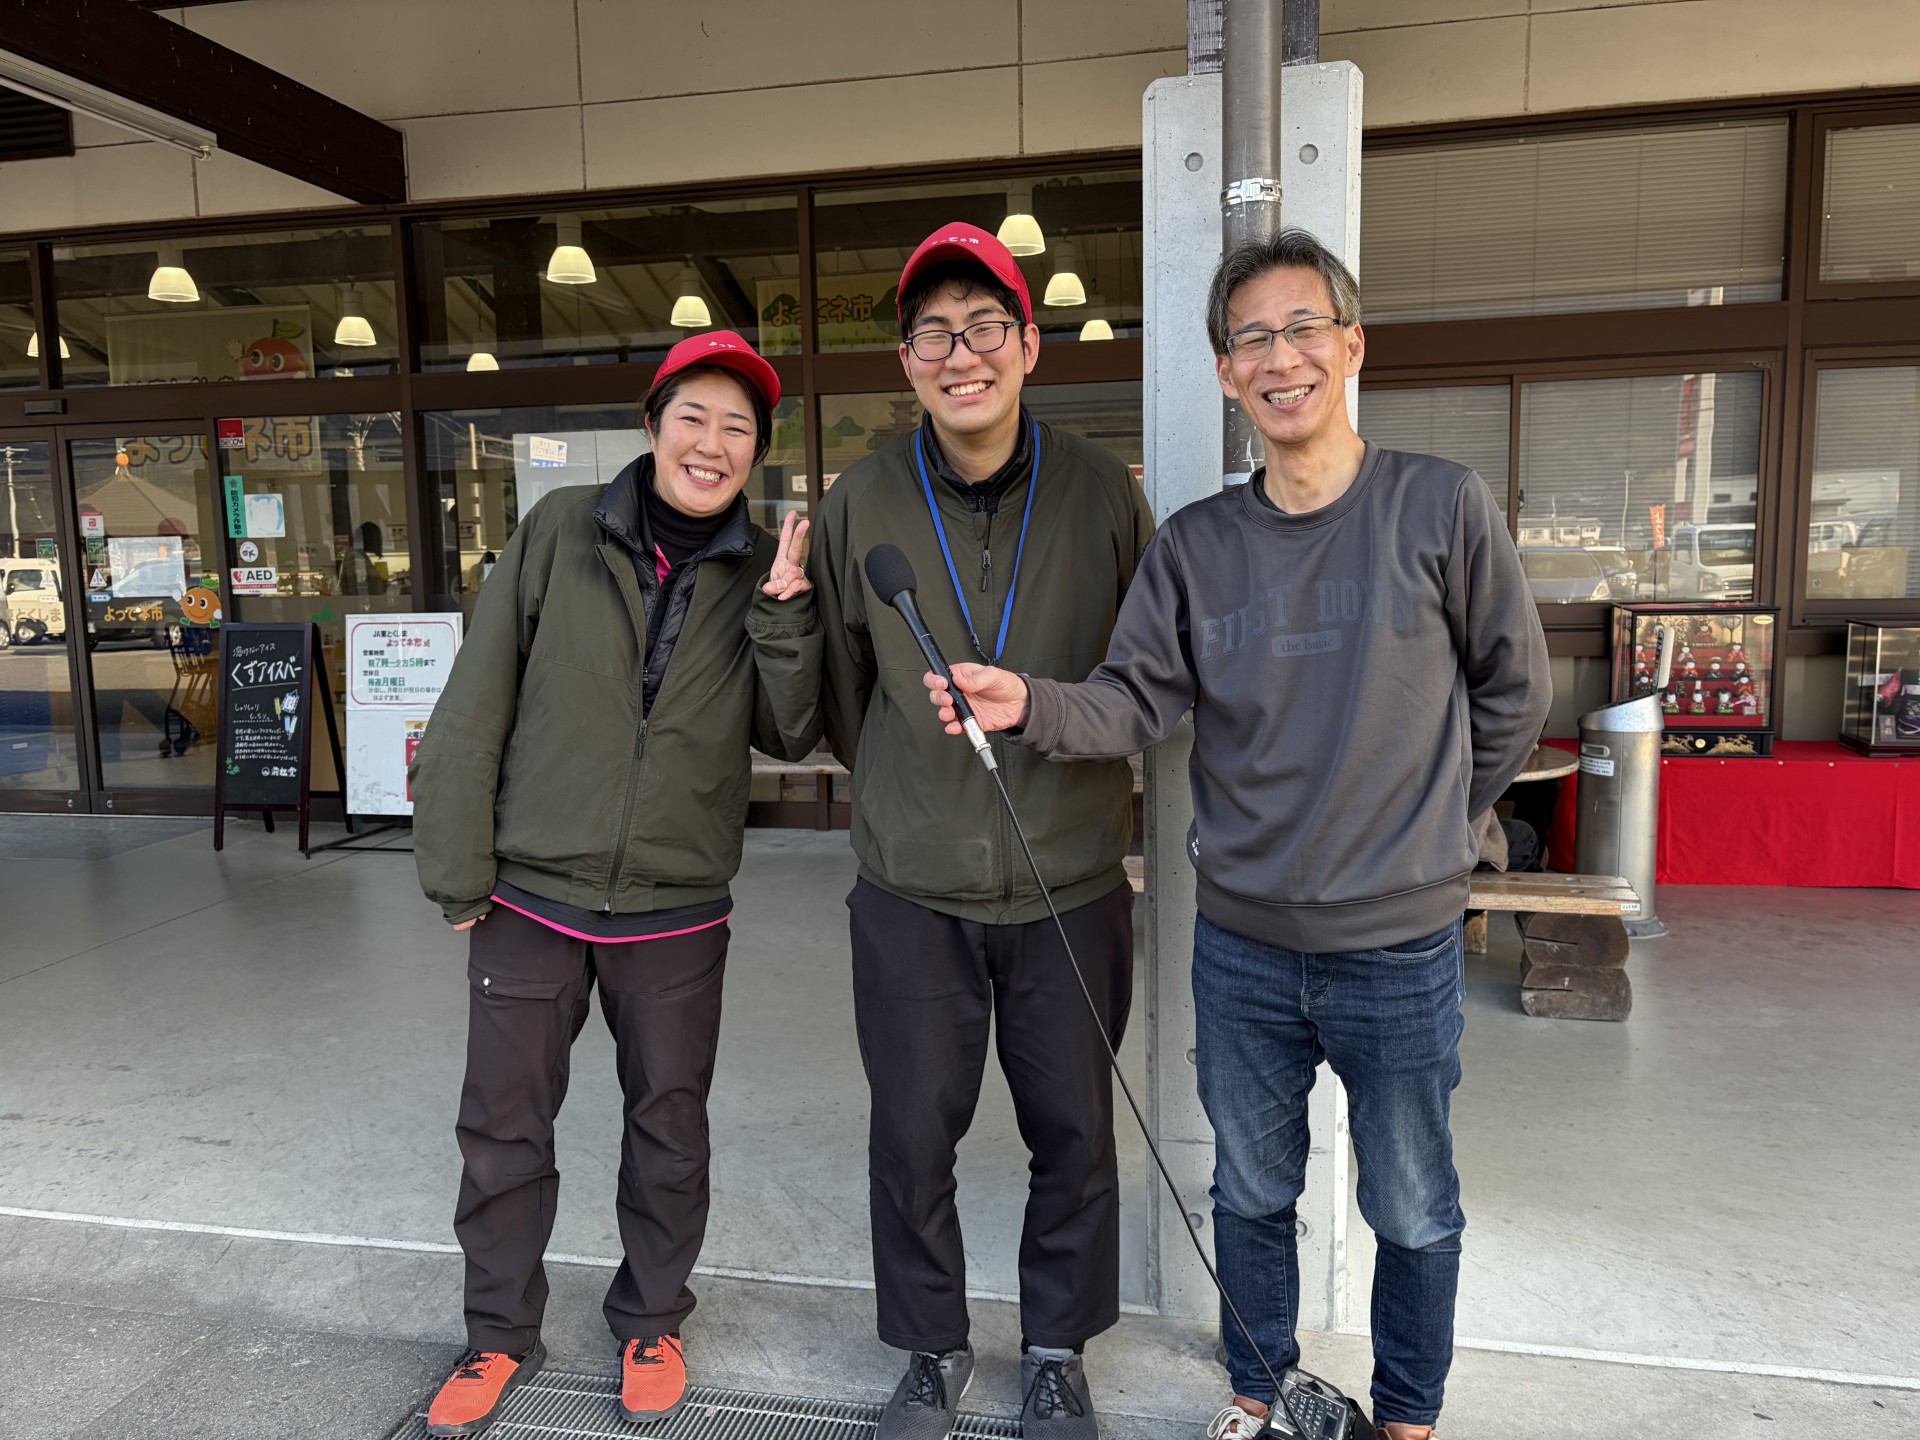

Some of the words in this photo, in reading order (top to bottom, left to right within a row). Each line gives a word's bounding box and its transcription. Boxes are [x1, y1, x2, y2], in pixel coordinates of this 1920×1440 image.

[230, 490, 242, 535] 防犯カメラ作動中
[246, 570, 273, 581] AED
[1305, 636, 1334, 651] basic
[231, 655, 302, 687] くずアイスバー
